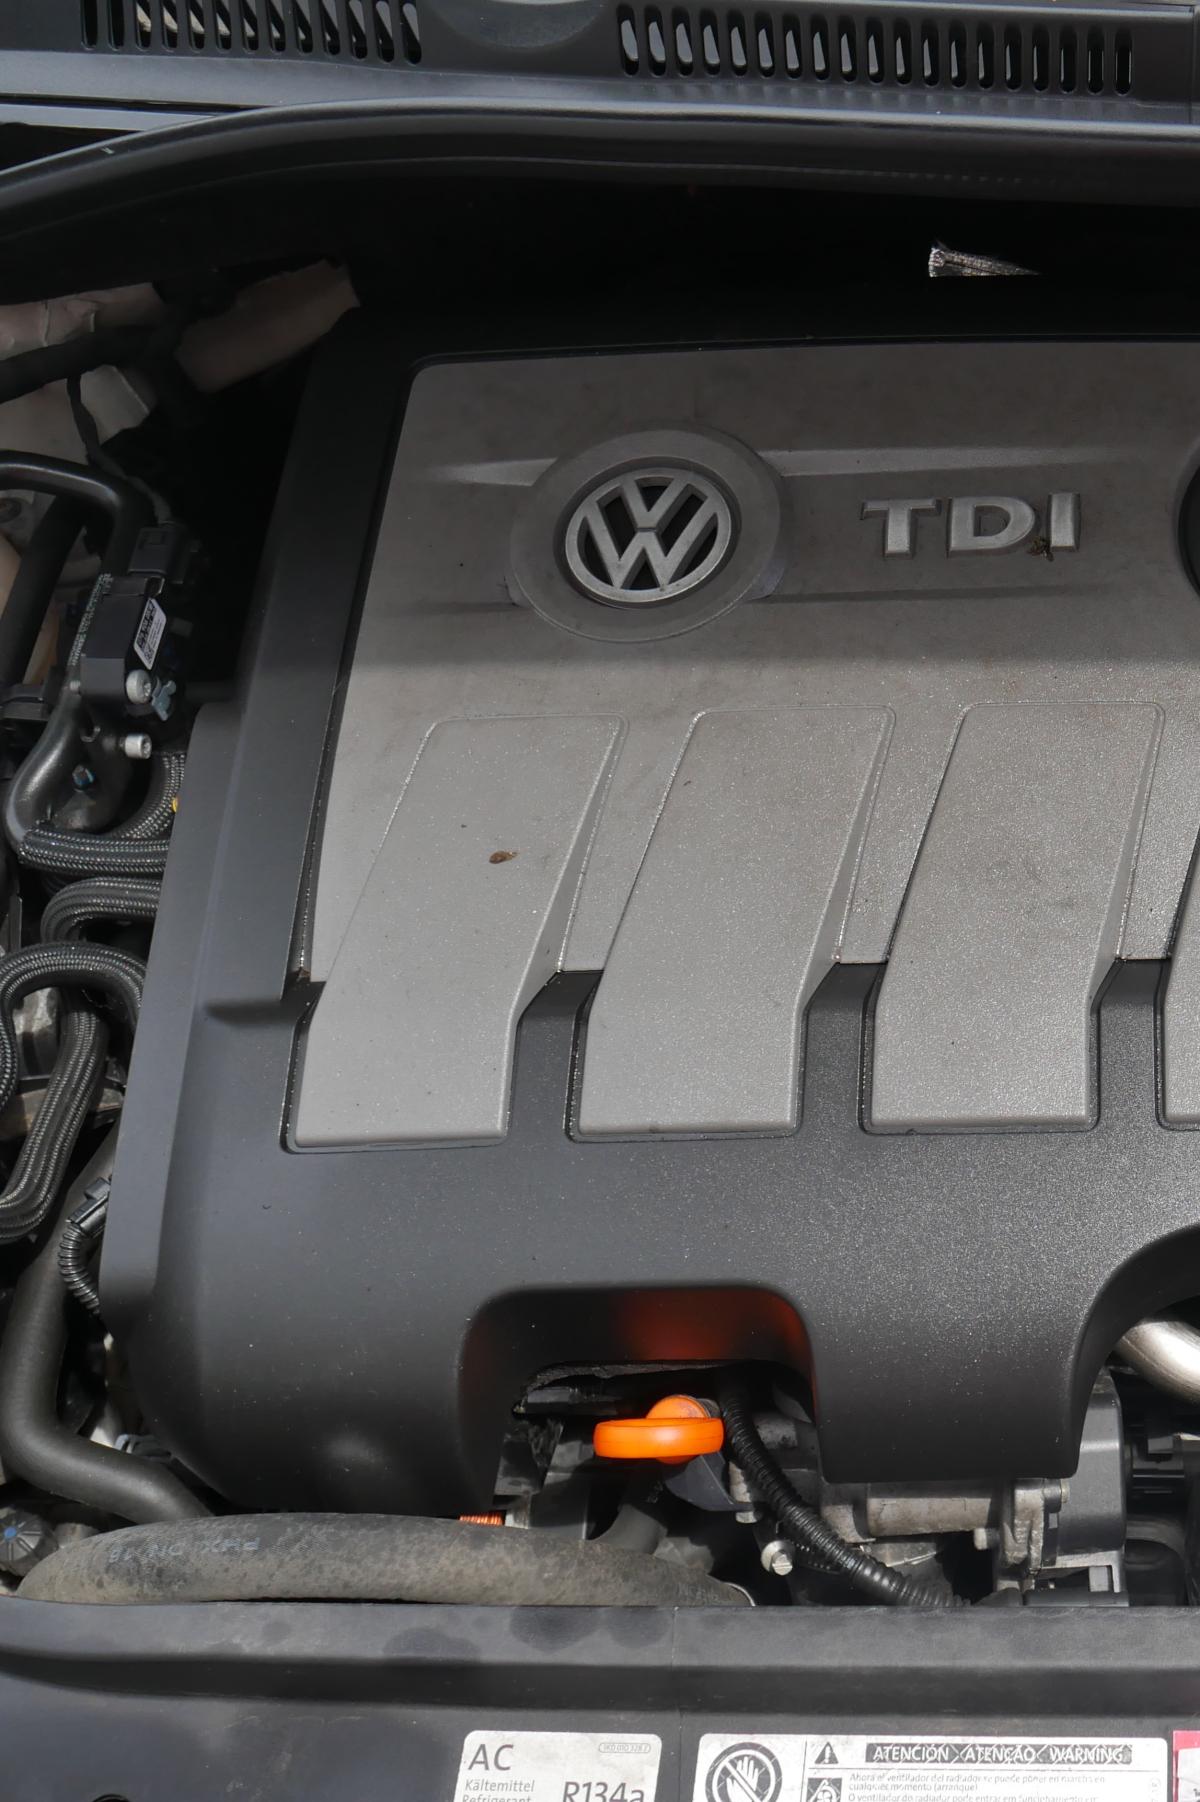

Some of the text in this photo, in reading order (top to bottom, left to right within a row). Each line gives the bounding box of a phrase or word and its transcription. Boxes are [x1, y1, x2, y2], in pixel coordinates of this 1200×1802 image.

[862, 492, 1080, 559] TDI
[468, 1743, 514, 1771] AC
[873, 1744, 949, 1761] ATENCIÓN
[1050, 1747, 1123, 1761] WARNING
[465, 1778, 535, 1793] Kältemittel
[563, 1782, 645, 1802] R134a
